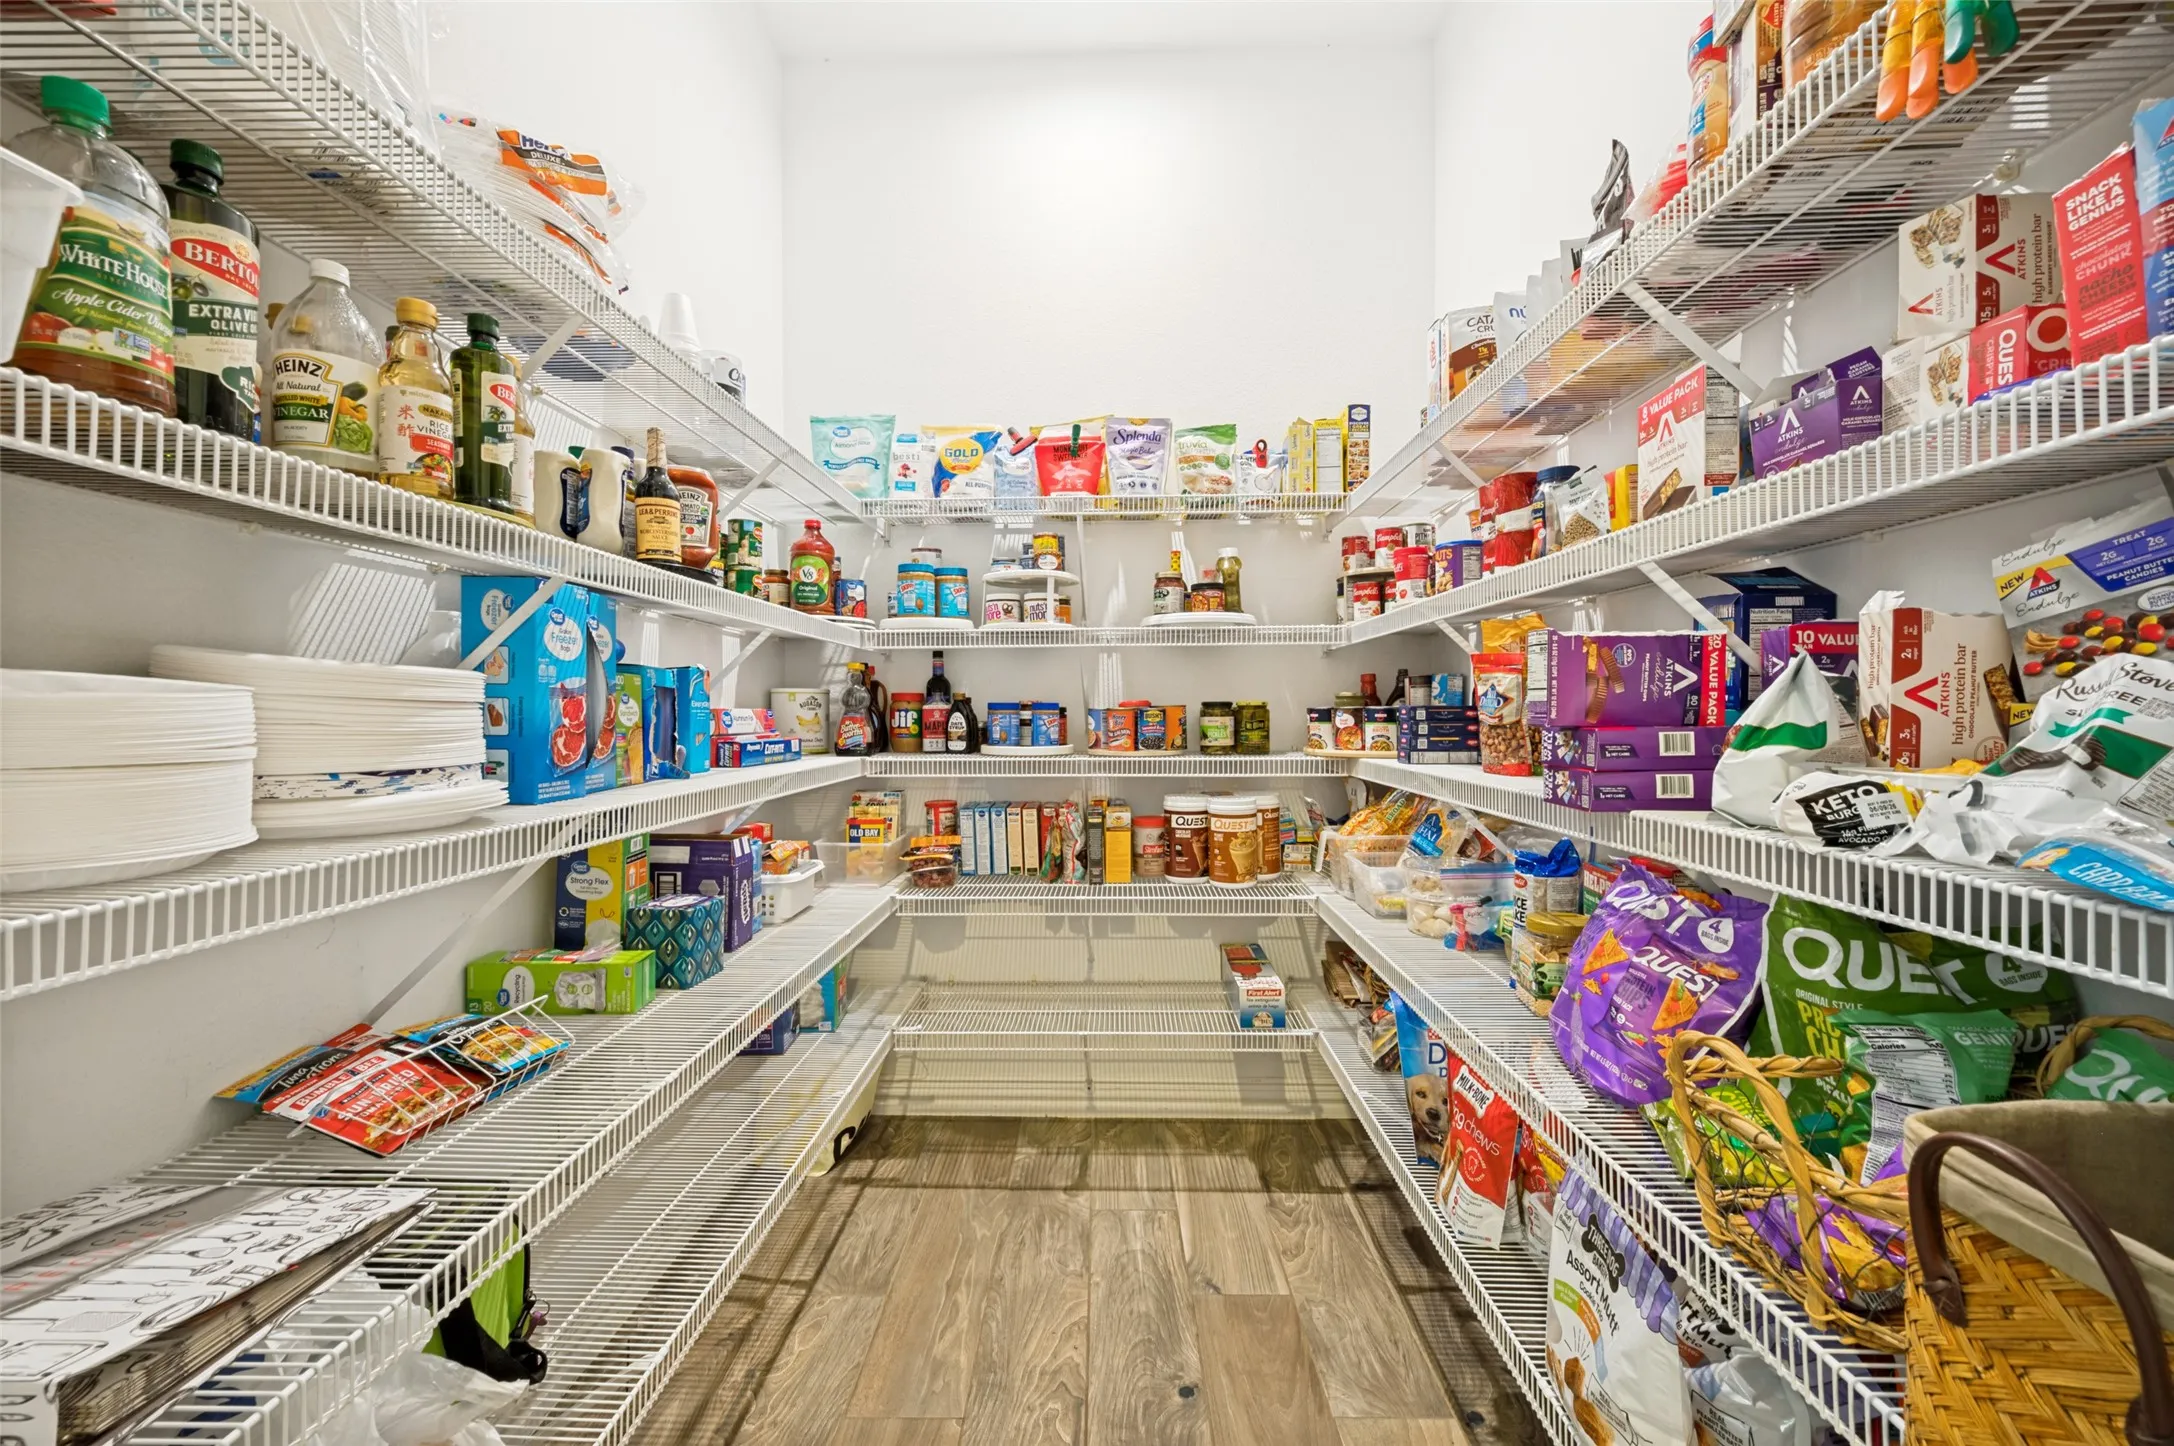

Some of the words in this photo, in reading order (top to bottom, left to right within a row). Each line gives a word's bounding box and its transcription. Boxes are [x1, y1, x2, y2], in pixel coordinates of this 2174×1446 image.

[530, 151, 561, 165] DELUXE
[2065, 172, 2122, 211] SNACK
[2067, 196, 2106, 222] LIKE
[2110, 184, 2124, 199] A
[2031, 213, 2042, 232] bar
[2068, 197, 2126, 232] GENIUS
[2017, 239, 2027, 280] ATKINS
[2032, 235, 2045, 275] protein
[2076, 248, 2133, 281] CHUNK
[184, 240, 259, 291] BERTOL
[2031, 278, 2045, 304] high
[52, 288, 105, 308] Apple
[106, 299, 146, 321] Cider
[188, 304, 243, 321] EXTRA
[210, 319, 249, 333] OLIVE
[1998, 328, 2017, 386] QUES
[275, 359, 323, 377] HEINZ
[286, 380, 322, 392] Natural
[1642, 407, 1648, 418] 8
[1649, 394, 1674, 415] VALUE
[1674, 375, 1699, 400] PACK
[417, 425, 454, 439] VINEGA
[430, 420, 449, 432] RICE
[1777, 427, 1804, 444] ATKINS
[1113, 428, 1162, 445] Splenda
[944, 447, 979, 458] GOLD
[2112, 530, 2147, 546] TREAT
[2001, 537, 2067, 567] Endulge
[2100, 550, 2117, 562] 2G
[2146, 535, 2165, 546] 2G
[800, 567, 814, 580] V8
[2106, 567, 2142, 582] PEANUT
[2142, 556, 2174, 572] BUTTE
[2124, 566, 2165, 582] CANDIES
[799, 585, 818, 593] Original
[2000, 572, 2025, 593] NEW
[2029, 583, 2059, 598] ATKINS
[2015, 591, 2080, 618] Endulge
[1029, 610, 1048, 620] mor
[551, 631, 577, 645] Freezer
[1796, 630, 1815, 643] 10
[1821, 655, 1831, 664] 2g
[1900, 648, 1912, 660] 2g
[1954, 643, 1966, 665] bar
[1664, 657, 1674, 698] ATKINS
[1708, 651, 1719, 689] VALUE
[2118, 661, 2174, 691] Stove
[1690, 694, 1699, 706] 80
[1941, 671, 1951, 718] ATKINS
[1953, 668, 1967, 713] protein
[1707, 691, 1718, 725] PACK
[2012, 709, 2034, 721] NEW
[891, 710, 918, 729] Jif
[924, 721, 948, 732] MAPL
[1900, 728, 1911, 740] 3g
[1951, 716, 1966, 746] high
[1810, 785, 1879, 815] KETO
[1175, 816, 1208, 827] QUEST
[1826, 805, 1860, 821] BURG
[849, 828, 863, 837] OLD
[864, 828, 879, 837] BAY
[1214, 819, 1250, 830] QUEST
[1838, 836, 1881, 844] AVOCADO
[569, 877, 593, 886] Strong
[594, 876, 609, 886] Flex
[1709, 920, 1721, 935] 4
[1632, 945, 1720, 1002] QUEST
[2001, 955, 2022, 974] 4
[1998, 974, 2017, 988] BAGS
[2017, 969, 2043, 985] INSIDE
[1247, 989, 1263, 997] First
[1795, 988, 1830, 1008] ORIGINAL
[469, 1001, 479, 1013] 13
[483, 1000, 492, 1013] 20
[441, 1025, 467, 1040] Tuna
[1871, 1042, 1907, 1050] Calories
[276, 1067, 310, 1090] Tuna
[298, 1072, 350, 1107] BUMBLE
[358, 1056, 382, 1074] BEE
[1456, 1072, 1471, 1092] MILK
[1473, 1085, 1490, 1110] BONE
[1463, 1120, 1502, 1157] chews
[1606, 1252, 1620, 1278] DOG
[1681, 1329, 1703, 1349] Trio
[1709, 1408, 1726, 1423] REAL
[1696, 1409, 1720, 1429] PEANUT
[1719, 1427, 1744, 1444] BUTTER
